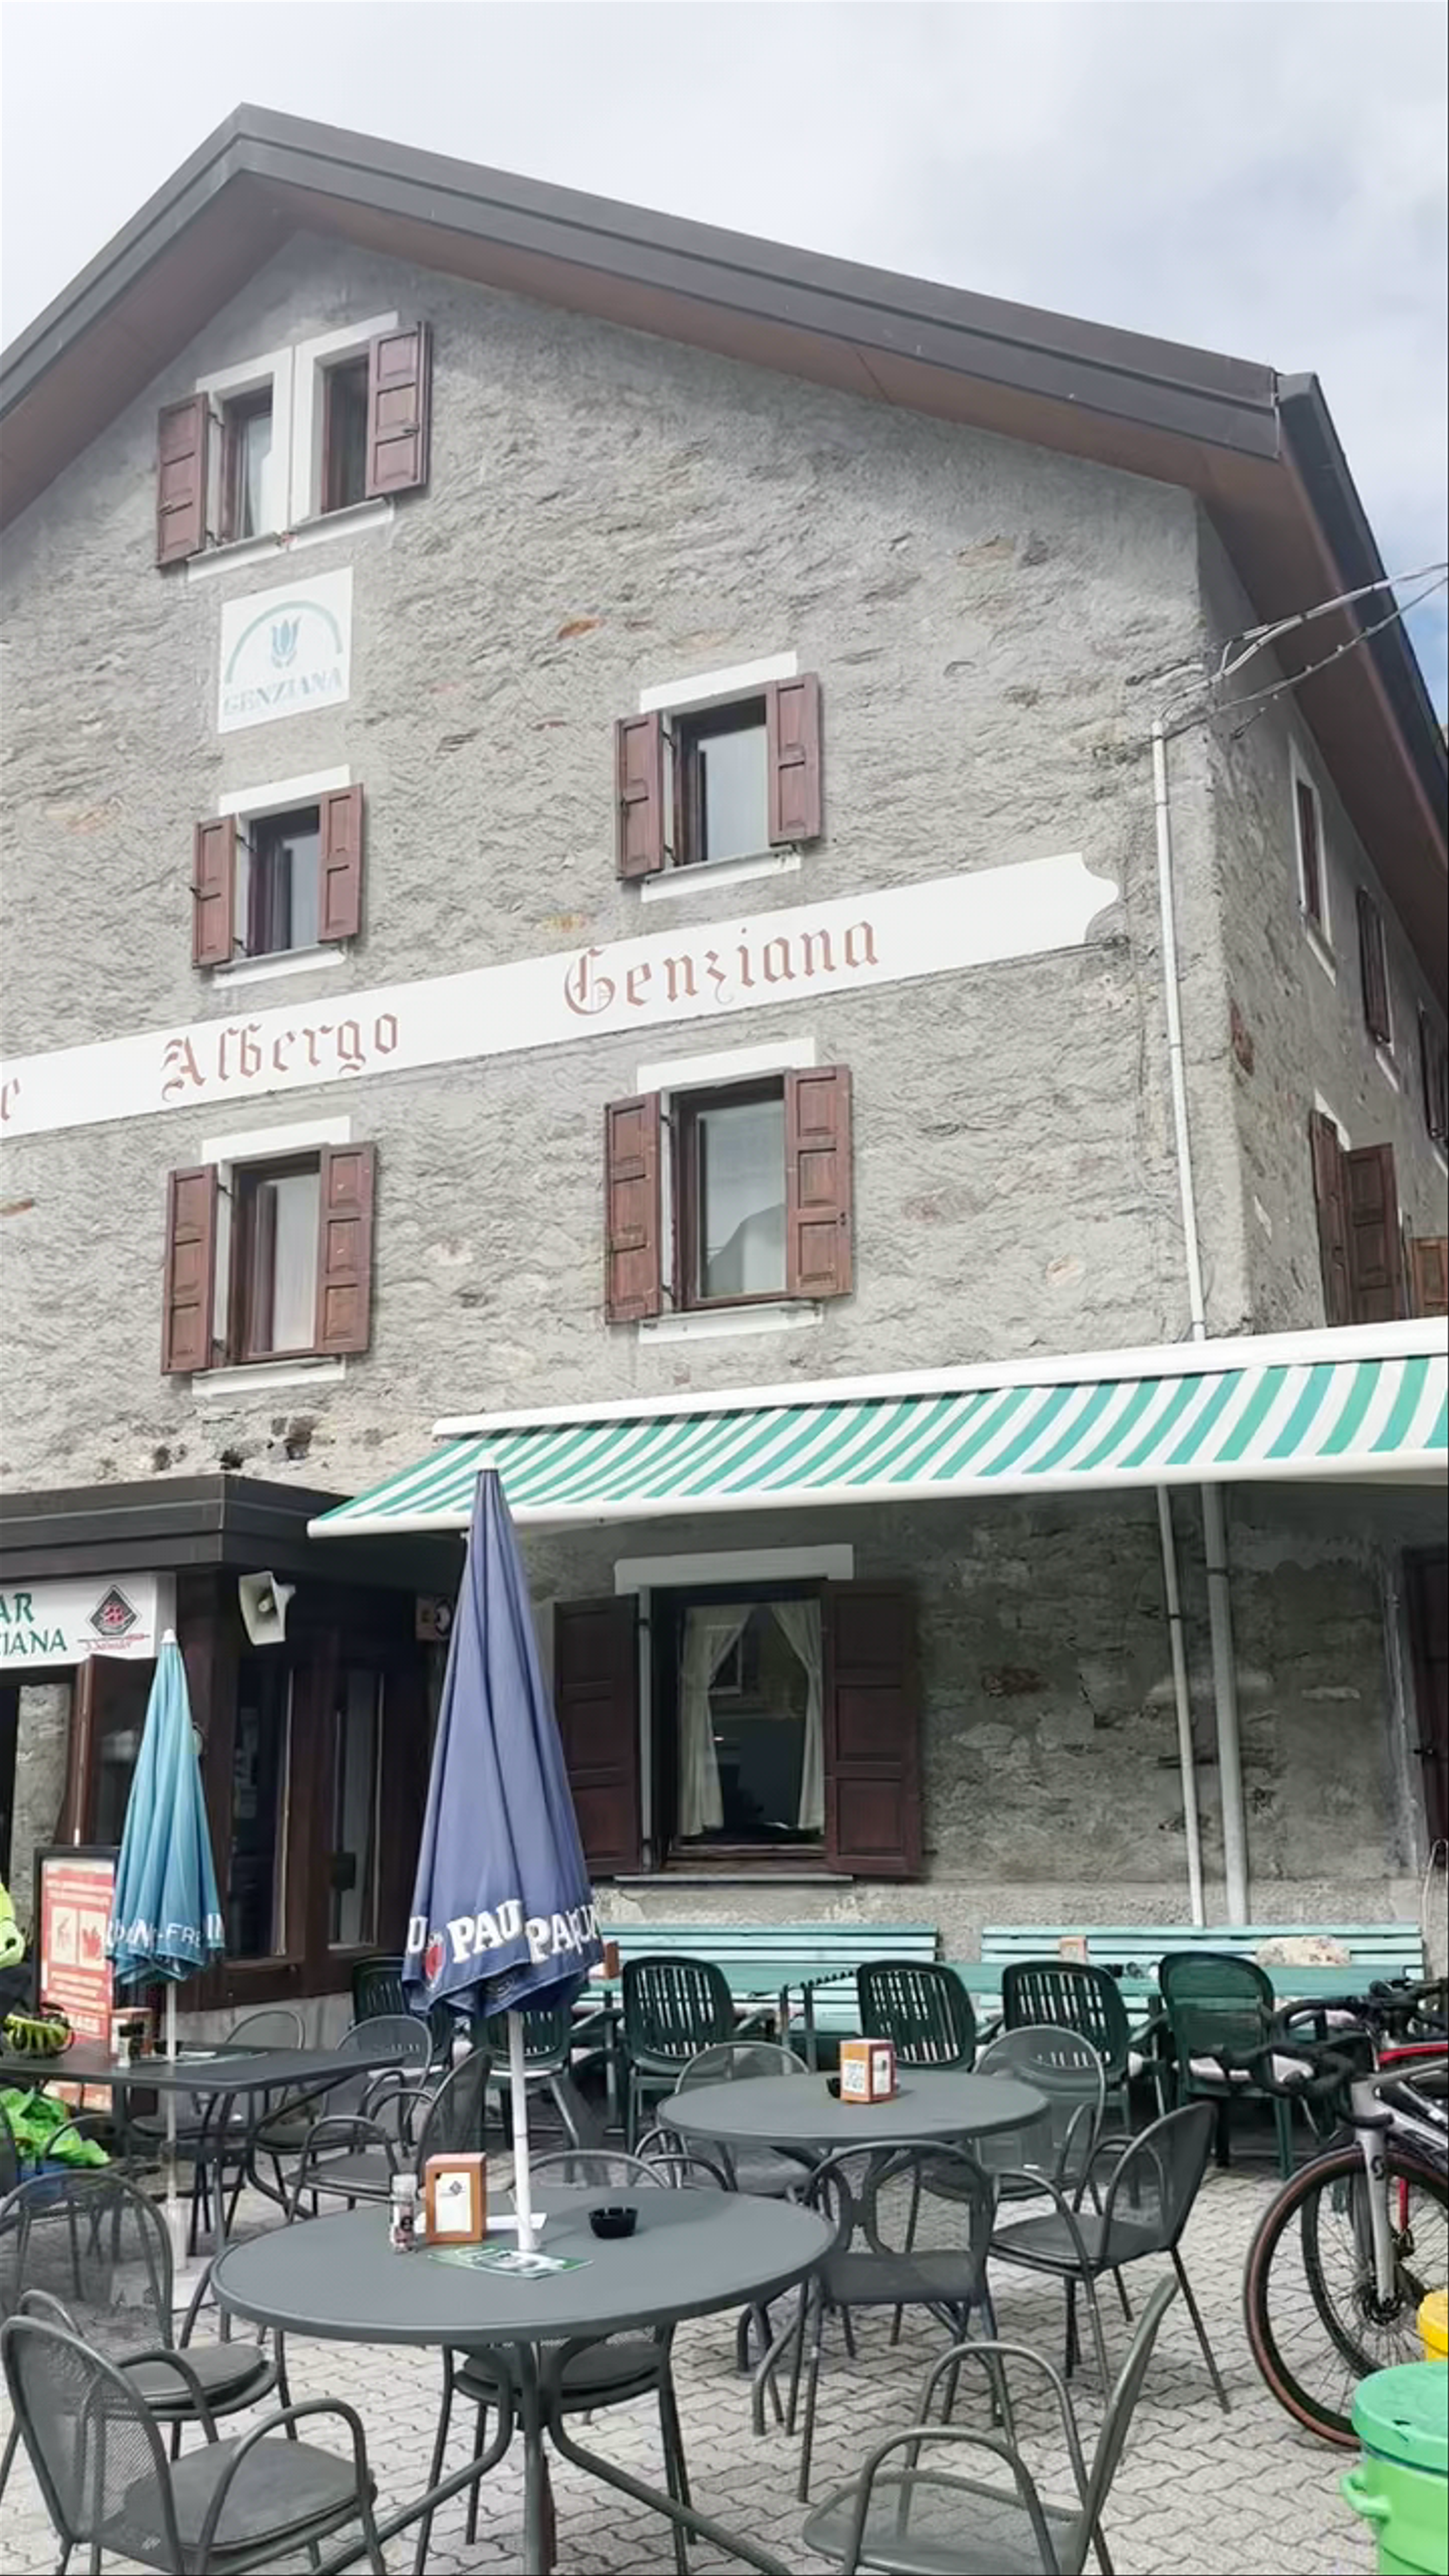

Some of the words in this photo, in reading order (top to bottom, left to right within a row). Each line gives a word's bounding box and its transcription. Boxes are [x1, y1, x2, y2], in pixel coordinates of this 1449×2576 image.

[161, 1013, 398, 1102] Albergo
[564, 921, 879, 1015] Genziana
[0, 1628, 67, 1656] IANA
